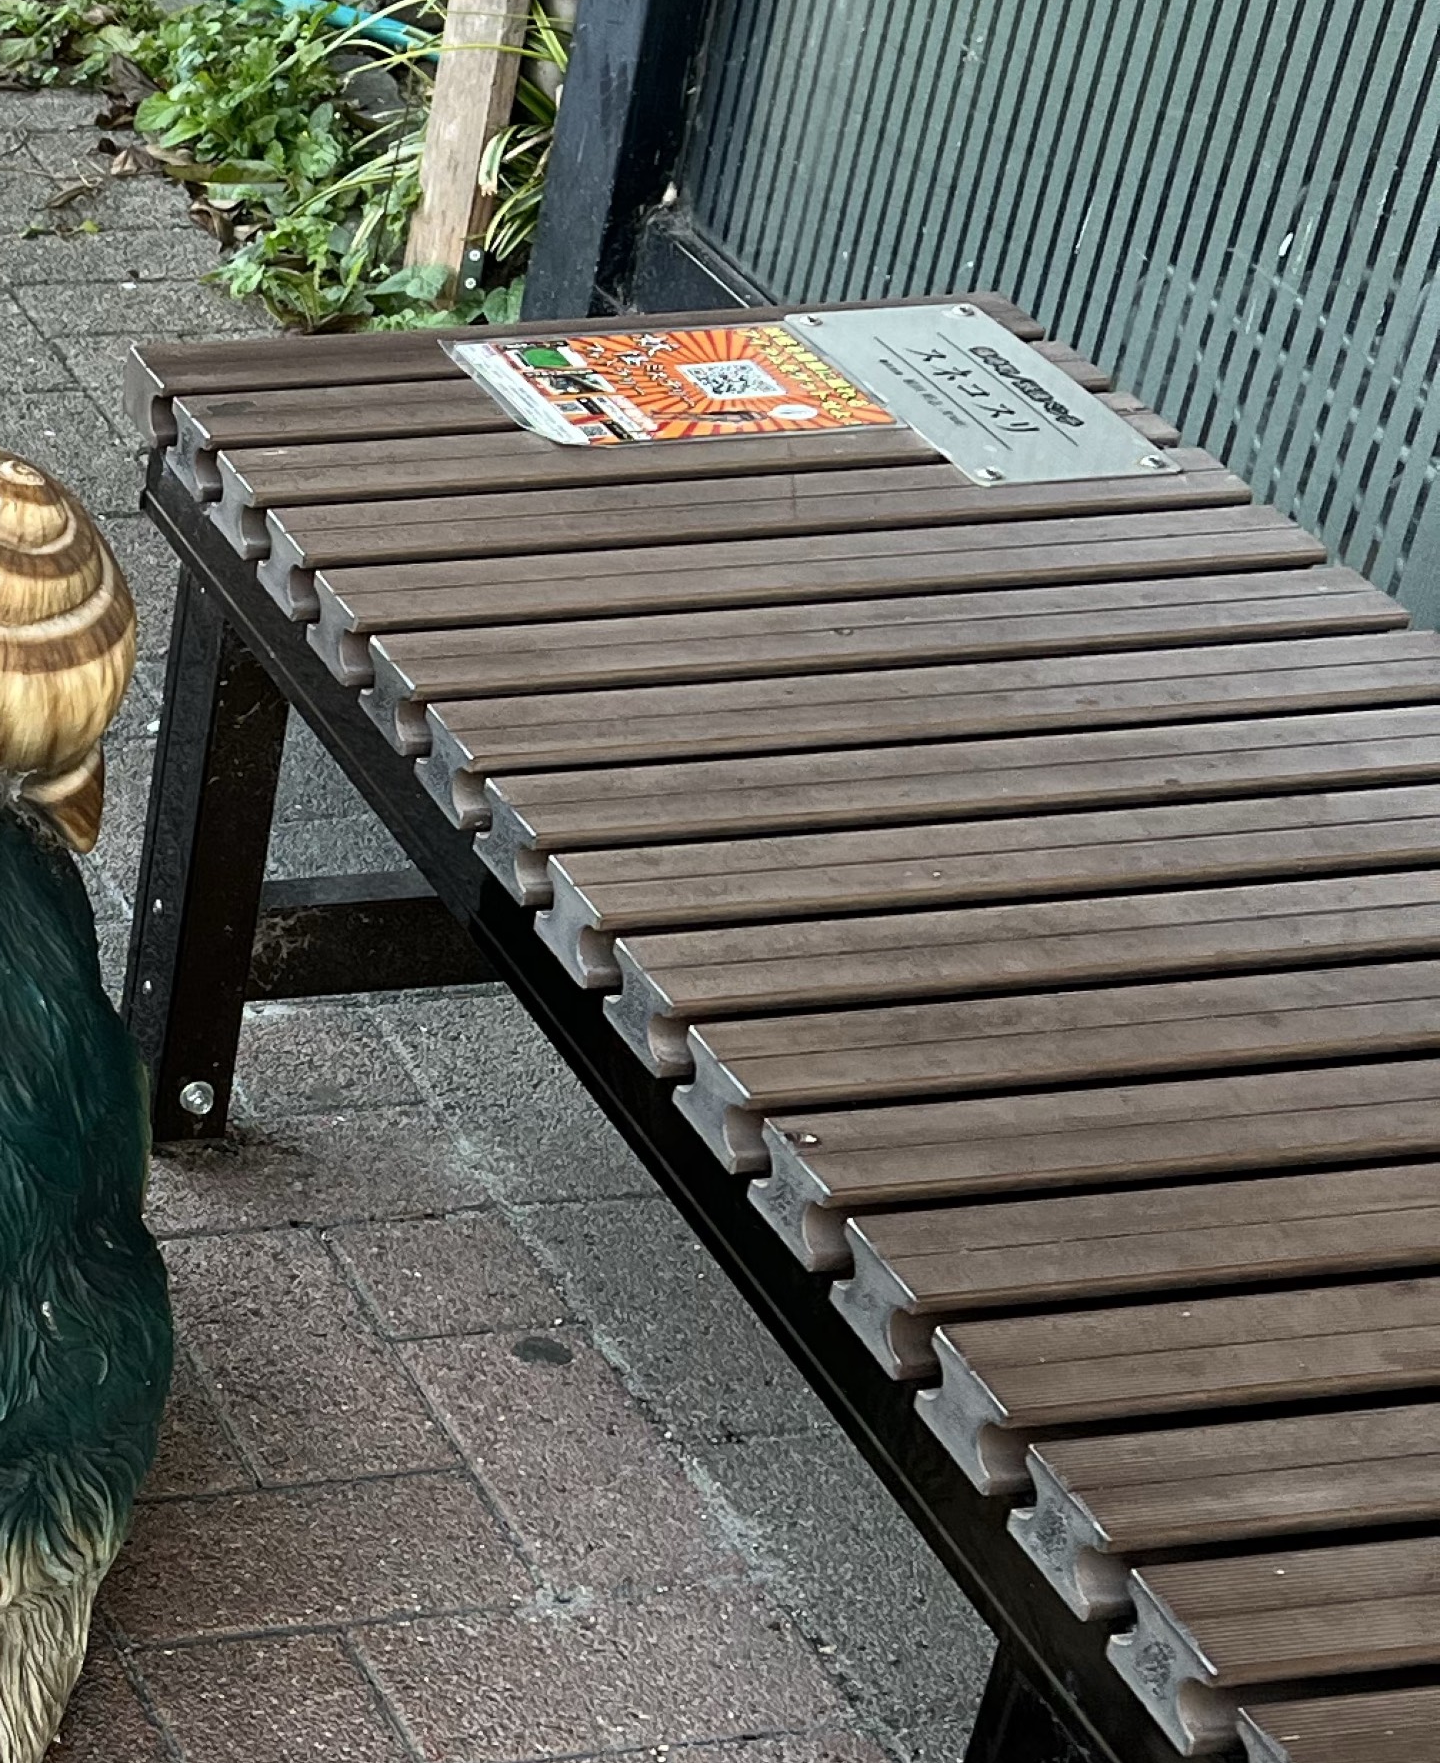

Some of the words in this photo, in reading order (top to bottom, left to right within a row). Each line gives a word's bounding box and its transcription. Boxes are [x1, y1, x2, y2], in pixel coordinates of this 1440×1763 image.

[904, 347, 1041, 432] スネコスリ
